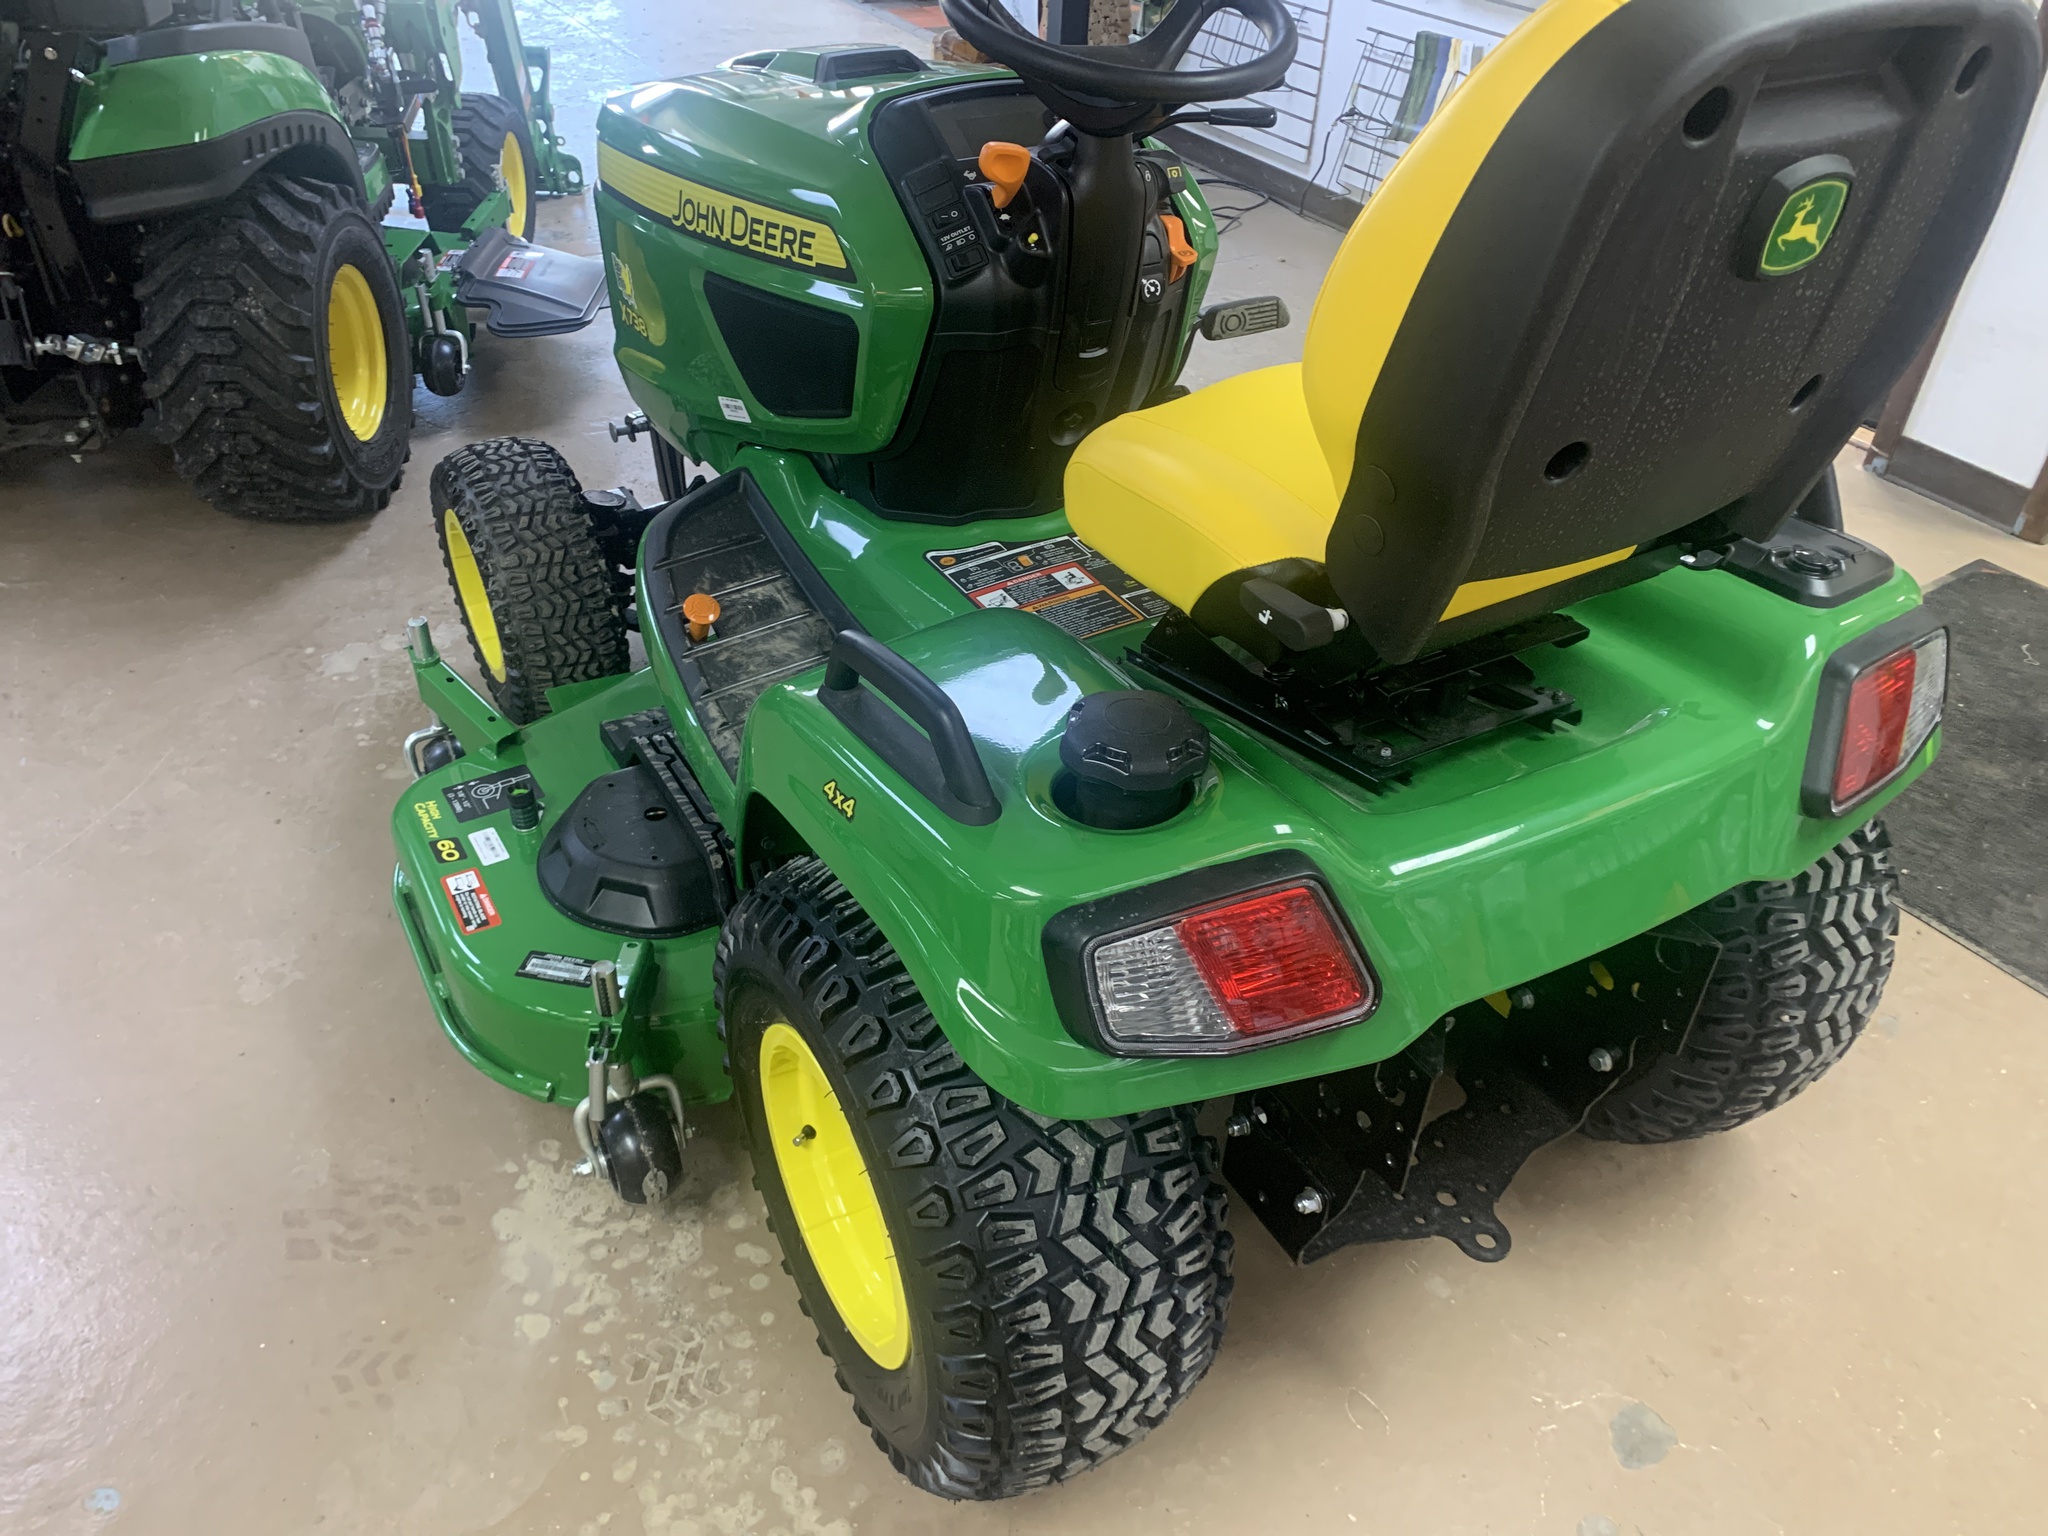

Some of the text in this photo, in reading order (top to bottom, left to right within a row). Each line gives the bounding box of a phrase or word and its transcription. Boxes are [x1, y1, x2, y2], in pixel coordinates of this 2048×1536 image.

[672, 190, 816, 262] JOHN DEERE
[436, 839, 460, 862] 60
